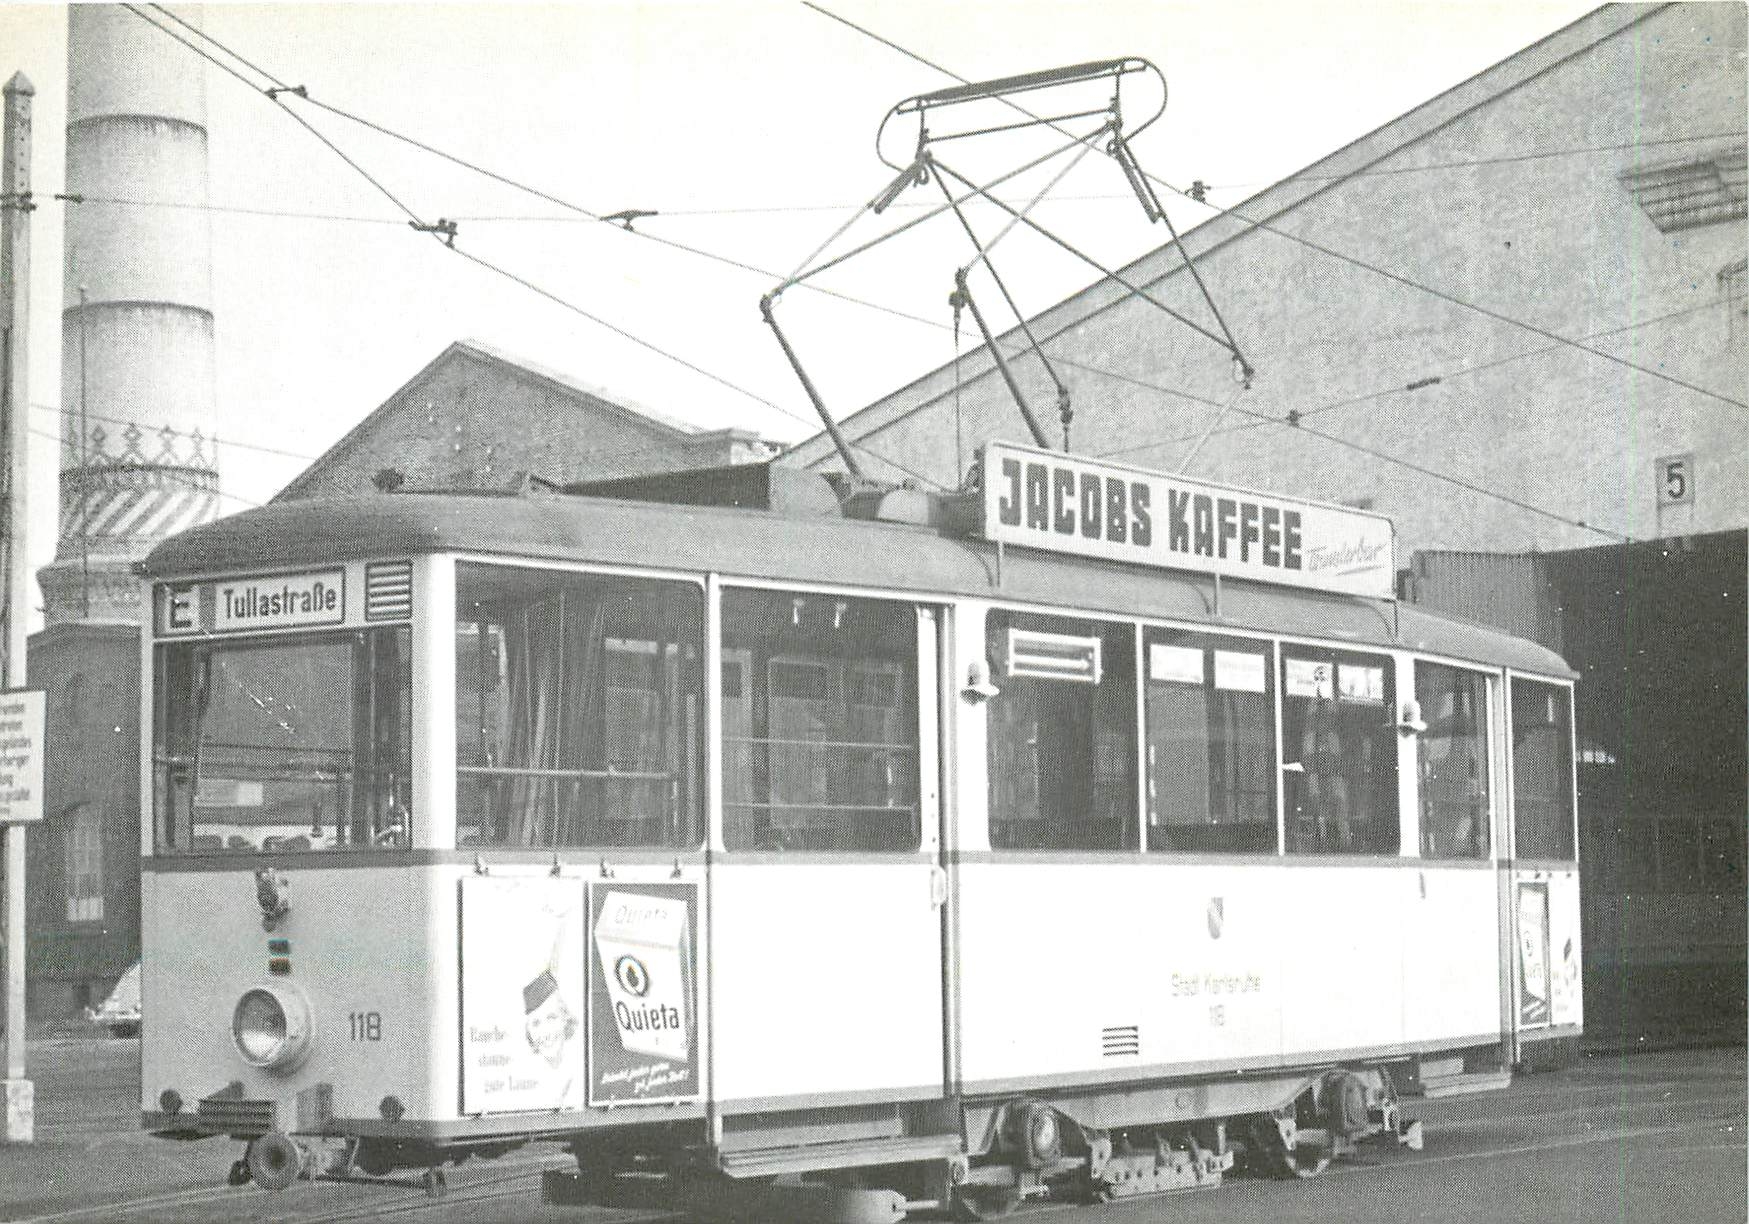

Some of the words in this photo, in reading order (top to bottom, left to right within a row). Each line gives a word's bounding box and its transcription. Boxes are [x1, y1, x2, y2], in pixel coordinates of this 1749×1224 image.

[1666, 462, 1686, 499] 5
[998, 457, 1151, 547] JACOBS
[1168, 488, 1302, 570] KAFFEE
[170, 584, 192, 629] E
[223, 582, 336, 620] Tullastraße
[348, 1011, 382, 1041] 118
[615, 1001, 680, 1033] Quieta
